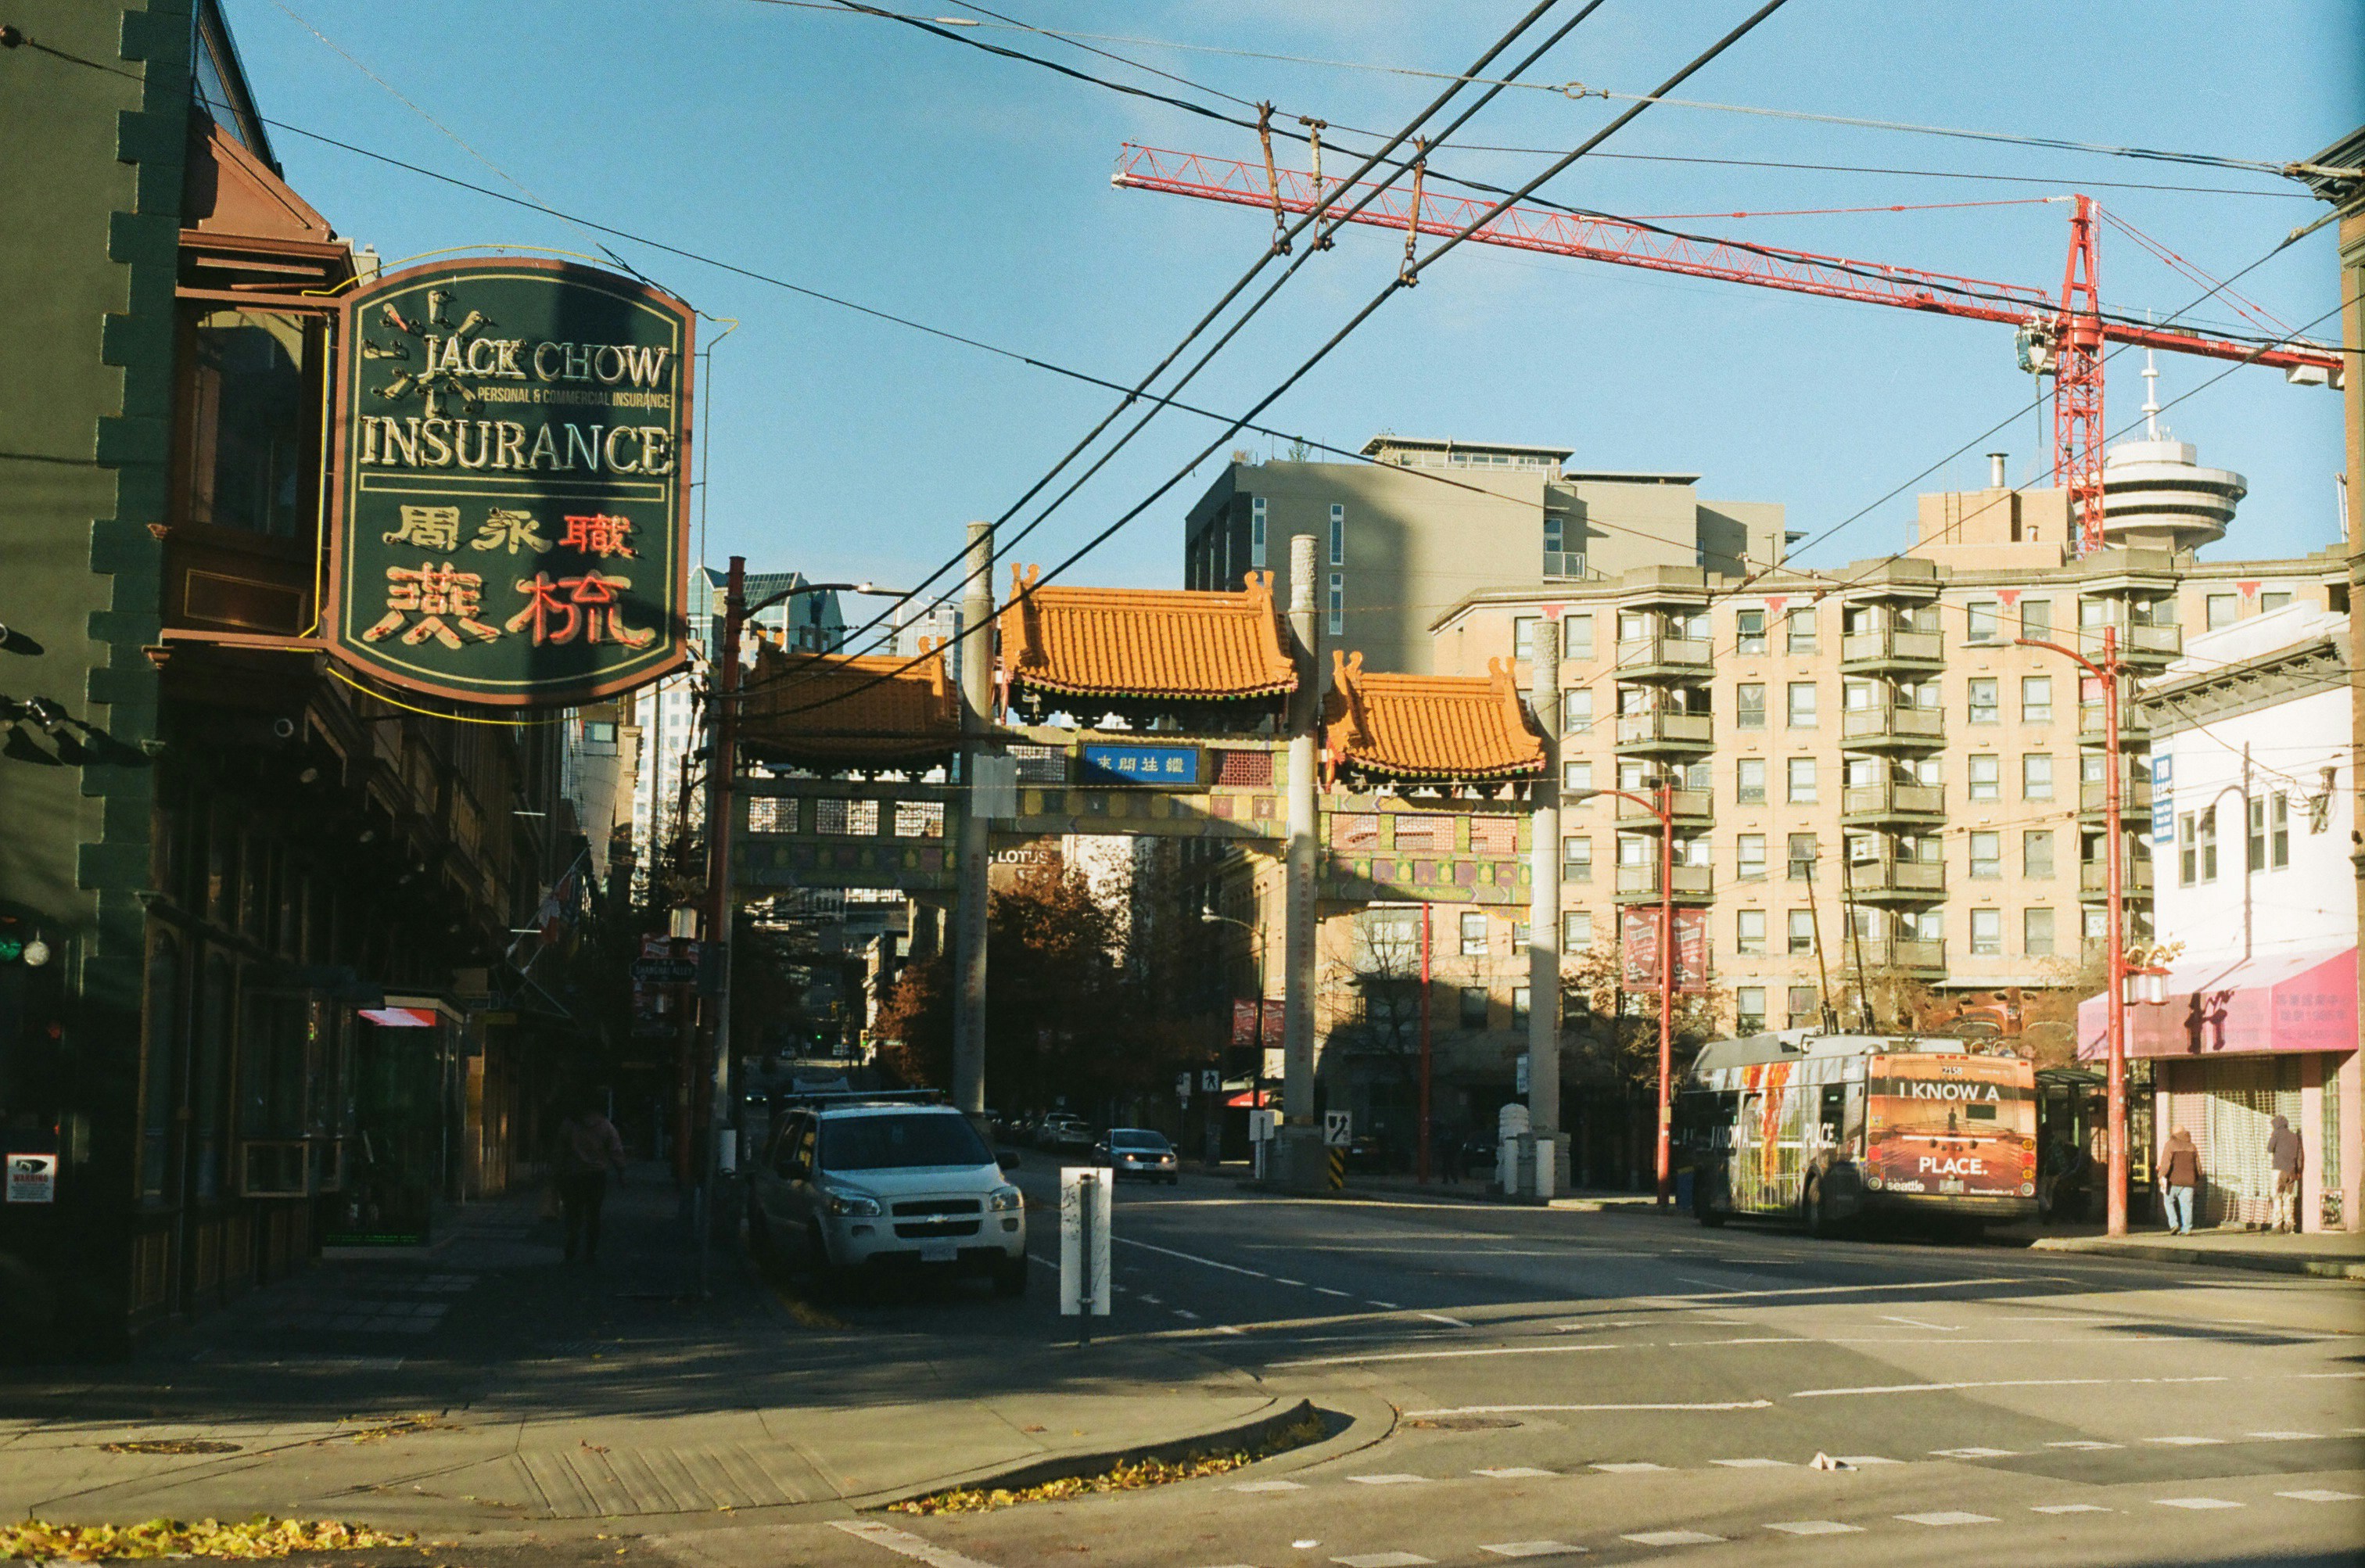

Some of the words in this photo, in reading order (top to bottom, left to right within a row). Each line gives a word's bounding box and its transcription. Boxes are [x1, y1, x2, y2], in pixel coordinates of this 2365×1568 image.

[418, 335, 527, 385] JACK
[533, 341, 670, 388] CHOW
[478, 386, 531, 403] PERSONAL
[533, 389, 540, 404] &
[543, 389, 610, 406] COMMERCIAL
[612, 392, 670, 408] INSURANCE
[359, 416, 673, 475] INSURANCE
[1943, 1067, 1963, 1076] 2158
[1899, 1082, 1904, 1099] I
[1911, 1083, 1979, 1101] KNOW
[1984, 1085, 2001, 1102] A
[1918, 1157, 1989, 1175] PLACE.
[13, 1174, 48, 1182] WARNING
[1886, 1180, 1925, 1192] seattle
